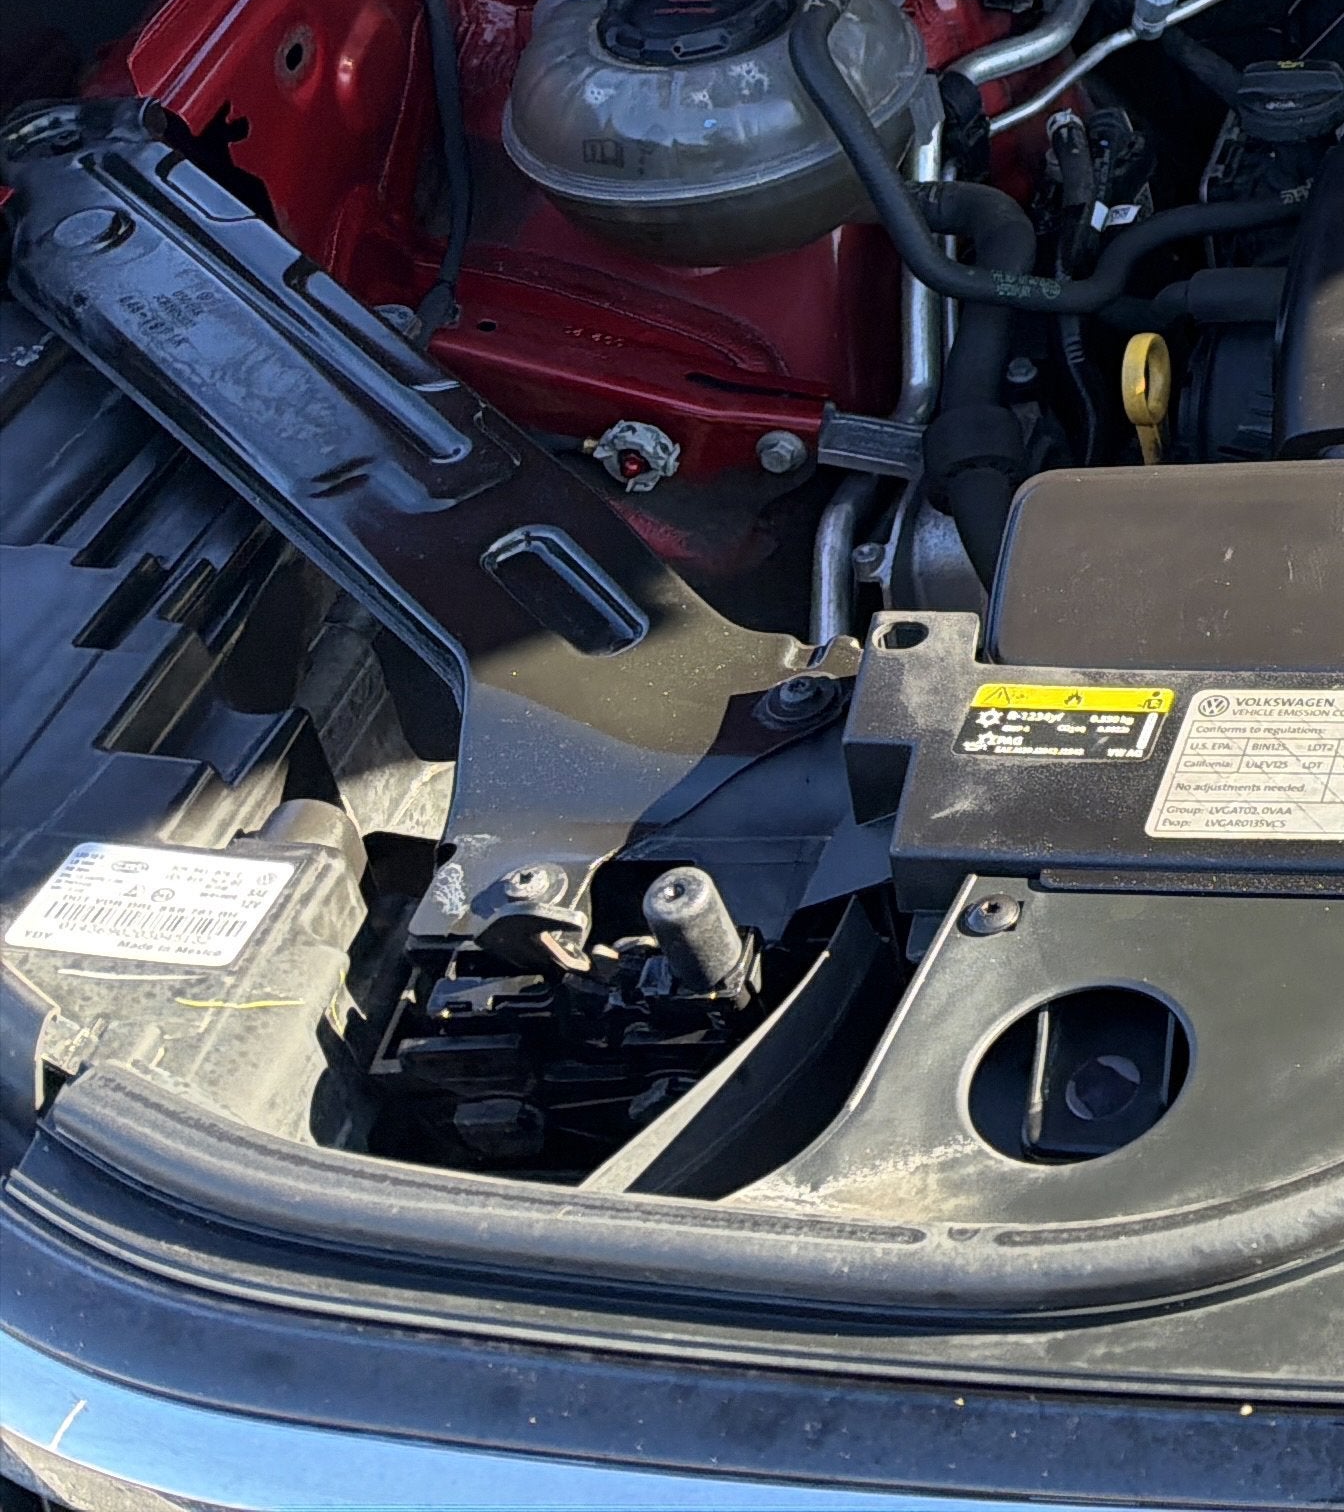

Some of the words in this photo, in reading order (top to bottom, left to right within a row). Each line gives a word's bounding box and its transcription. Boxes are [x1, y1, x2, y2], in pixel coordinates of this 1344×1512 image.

[1235, 697, 1336, 708] VOLKSWAGEN
[1232, 708, 1275, 717] VEHICLE
[1277, 708, 1330, 717] EMISSION
[1196, 725, 1247, 734] Conforms
[1250, 726, 1260, 734] to
[1175, 783, 1192, 791] No
[1193, 783, 1261, 794] adjustments
